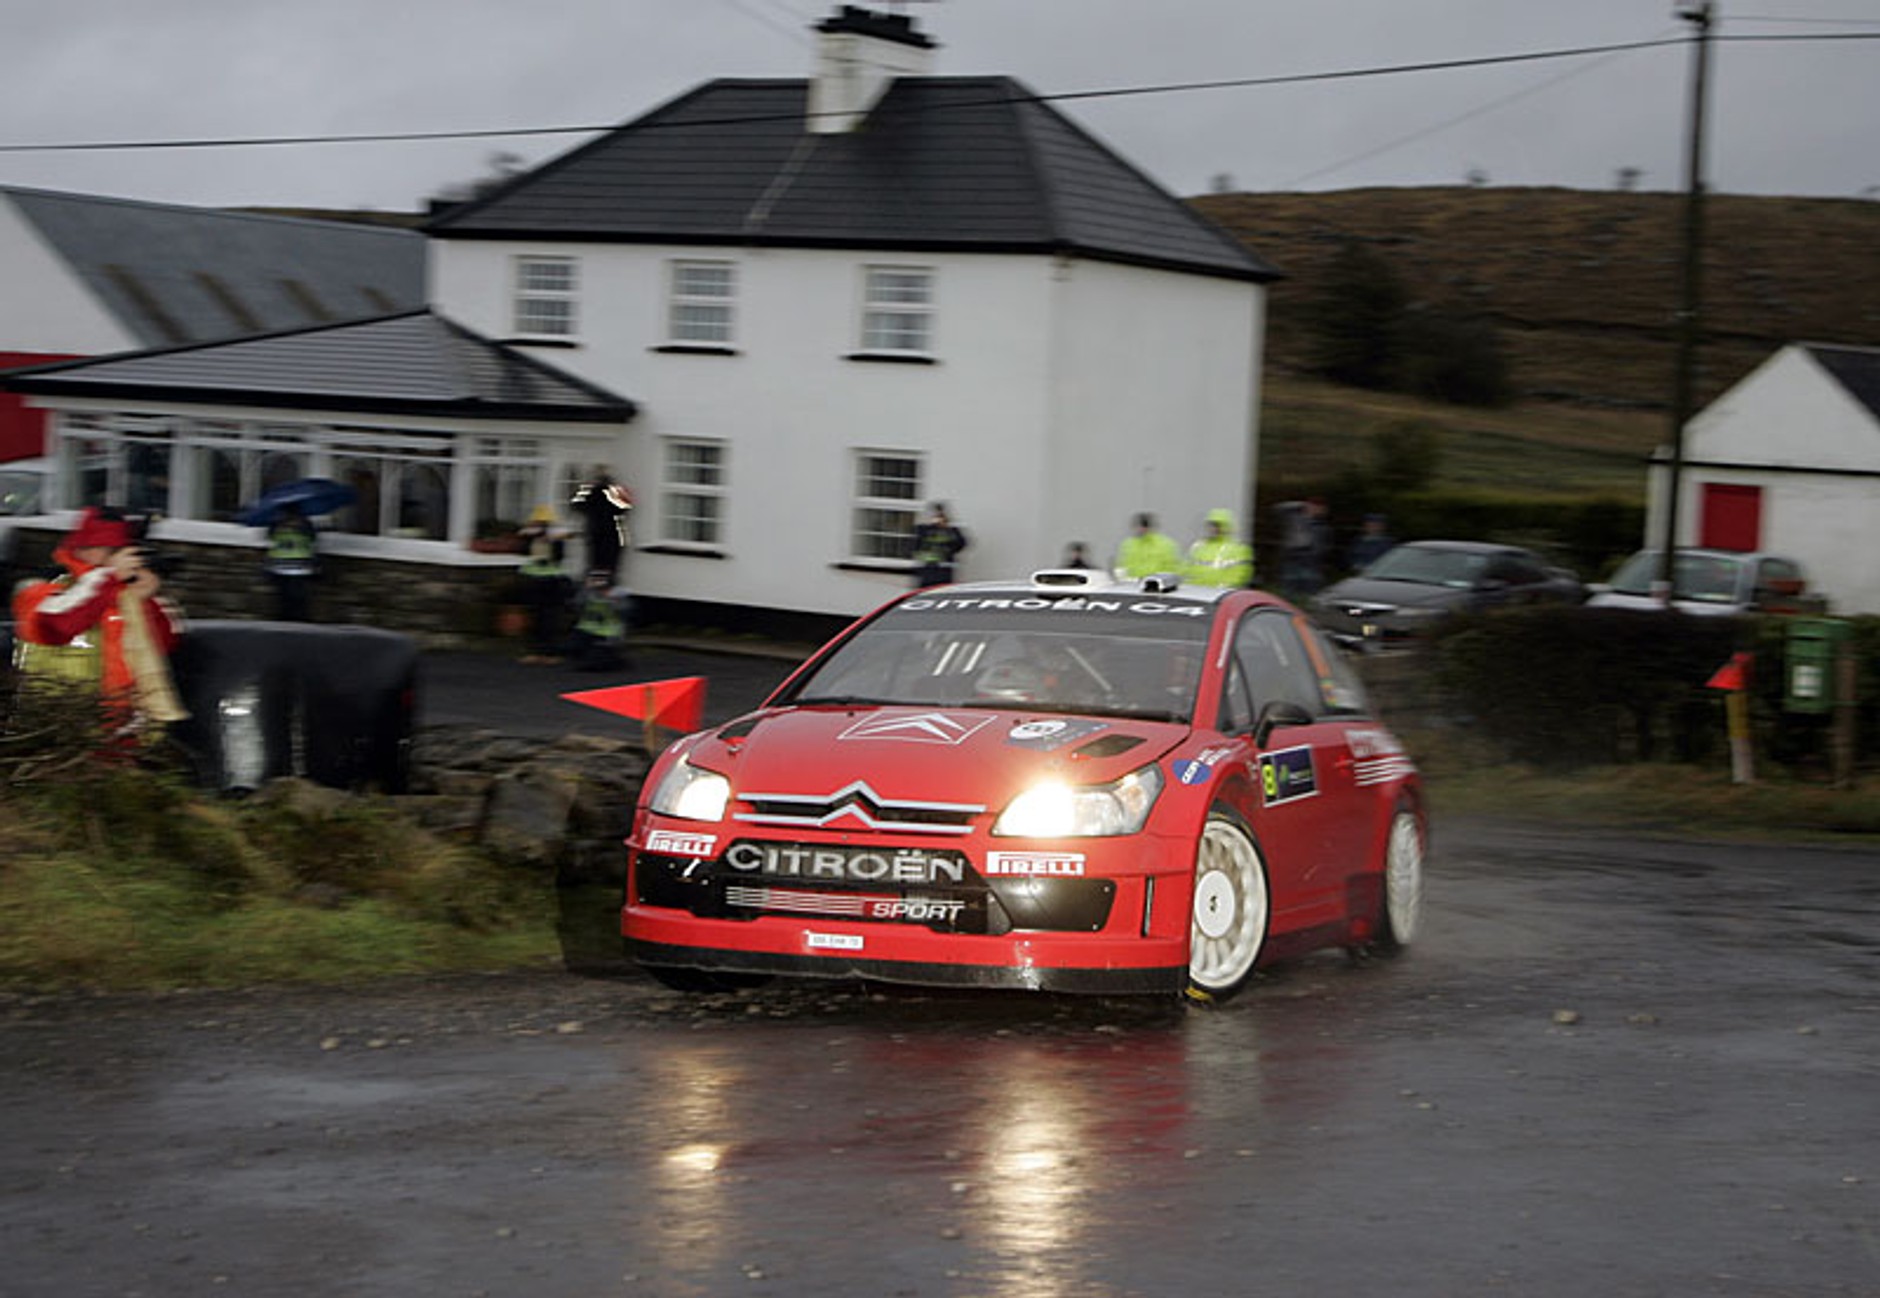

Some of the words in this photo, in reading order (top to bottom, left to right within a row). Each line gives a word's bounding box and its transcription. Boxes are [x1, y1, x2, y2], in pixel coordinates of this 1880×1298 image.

[901, 597, 1121, 612] CITROËN
[1130, 602, 1206, 617] C4
[646, 830, 717, 857] PIRELLI
[726, 843, 965, 883] CITROËN
[986, 851, 1085, 876] PIRELLI
[872, 901, 966, 921] SPORT
